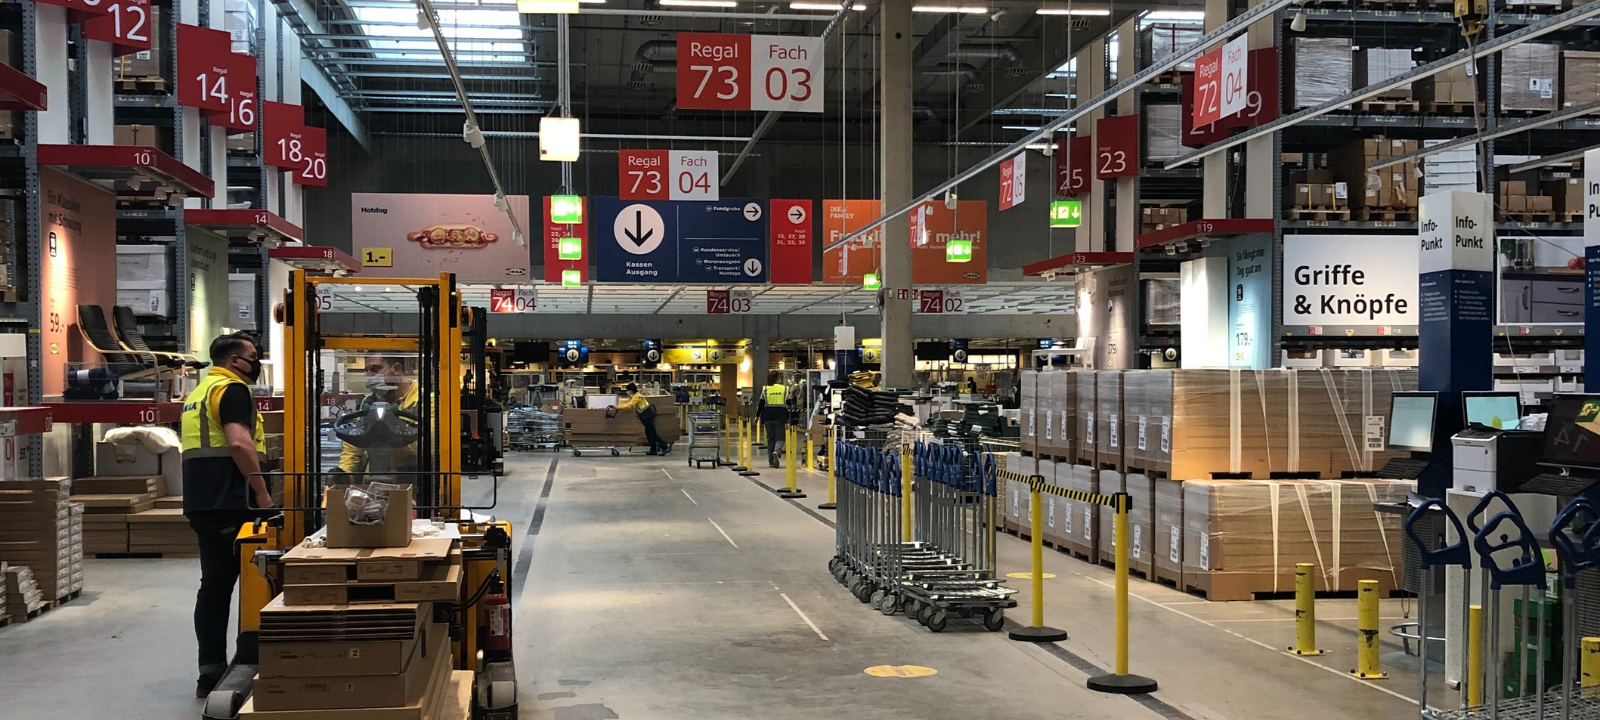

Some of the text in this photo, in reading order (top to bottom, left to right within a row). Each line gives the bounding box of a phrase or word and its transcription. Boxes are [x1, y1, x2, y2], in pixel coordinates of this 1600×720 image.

[108, 4, 148, 42] 12
[690, 42, 738, 62] Regal
[769, 45, 807, 60] Fach
[1228, 48, 1242, 65] Fach
[213, 66, 228, 74] Regal
[1200, 58, 1218, 78] Regal
[196, 73, 228, 104] 14
[690, 66, 739, 100] 73
[765, 67, 812, 102] 03
[1226, 68, 1242, 105] 04
[240, 90, 253, 98] Regal
[1198, 80, 1218, 117] 72
[278, 138, 302, 162] 18
[134, 152, 150, 165] 10
[628, 156, 660, 168] Regal
[680, 157, 707, 167] Fach
[1100, 150, 1126, 174] 23
[302, 157, 326, 179] 20
[628, 171, 662, 194] 73
[678, 172, 711, 194] 04
[1060, 168, 1084, 190] 25
[1002, 180, 1012, 204] 72
[255, 214, 266, 224] 14
[1421, 219, 1438, 233] Info-
[1456, 216, 1477, 229] Info-
[1203, 224, 1212, 232] 19
[936, 231, 981, 243] mehr!
[1421, 237, 1442, 252] Punkt
[1456, 234, 1483, 249] Punkt
[323, 250, 333, 258] 18
[366, 252, 386, 262] 1.-
[1294, 265, 1365, 286] Griffe
[492, 296, 513, 311] 74
[516, 296, 536, 311] 04
[709, 298, 728, 312] 74
[732, 298, 750, 312] 03
[922, 299, 940, 312] 74
[944, 298, 962, 312] 02
[1294, 295, 1312, 315] &
[1320, 294, 1408, 320] Knöpfe
[50, 313, 64, 333] 59.-
[258, 402, 270, 411] 14
[139, 410, 154, 422] 10
